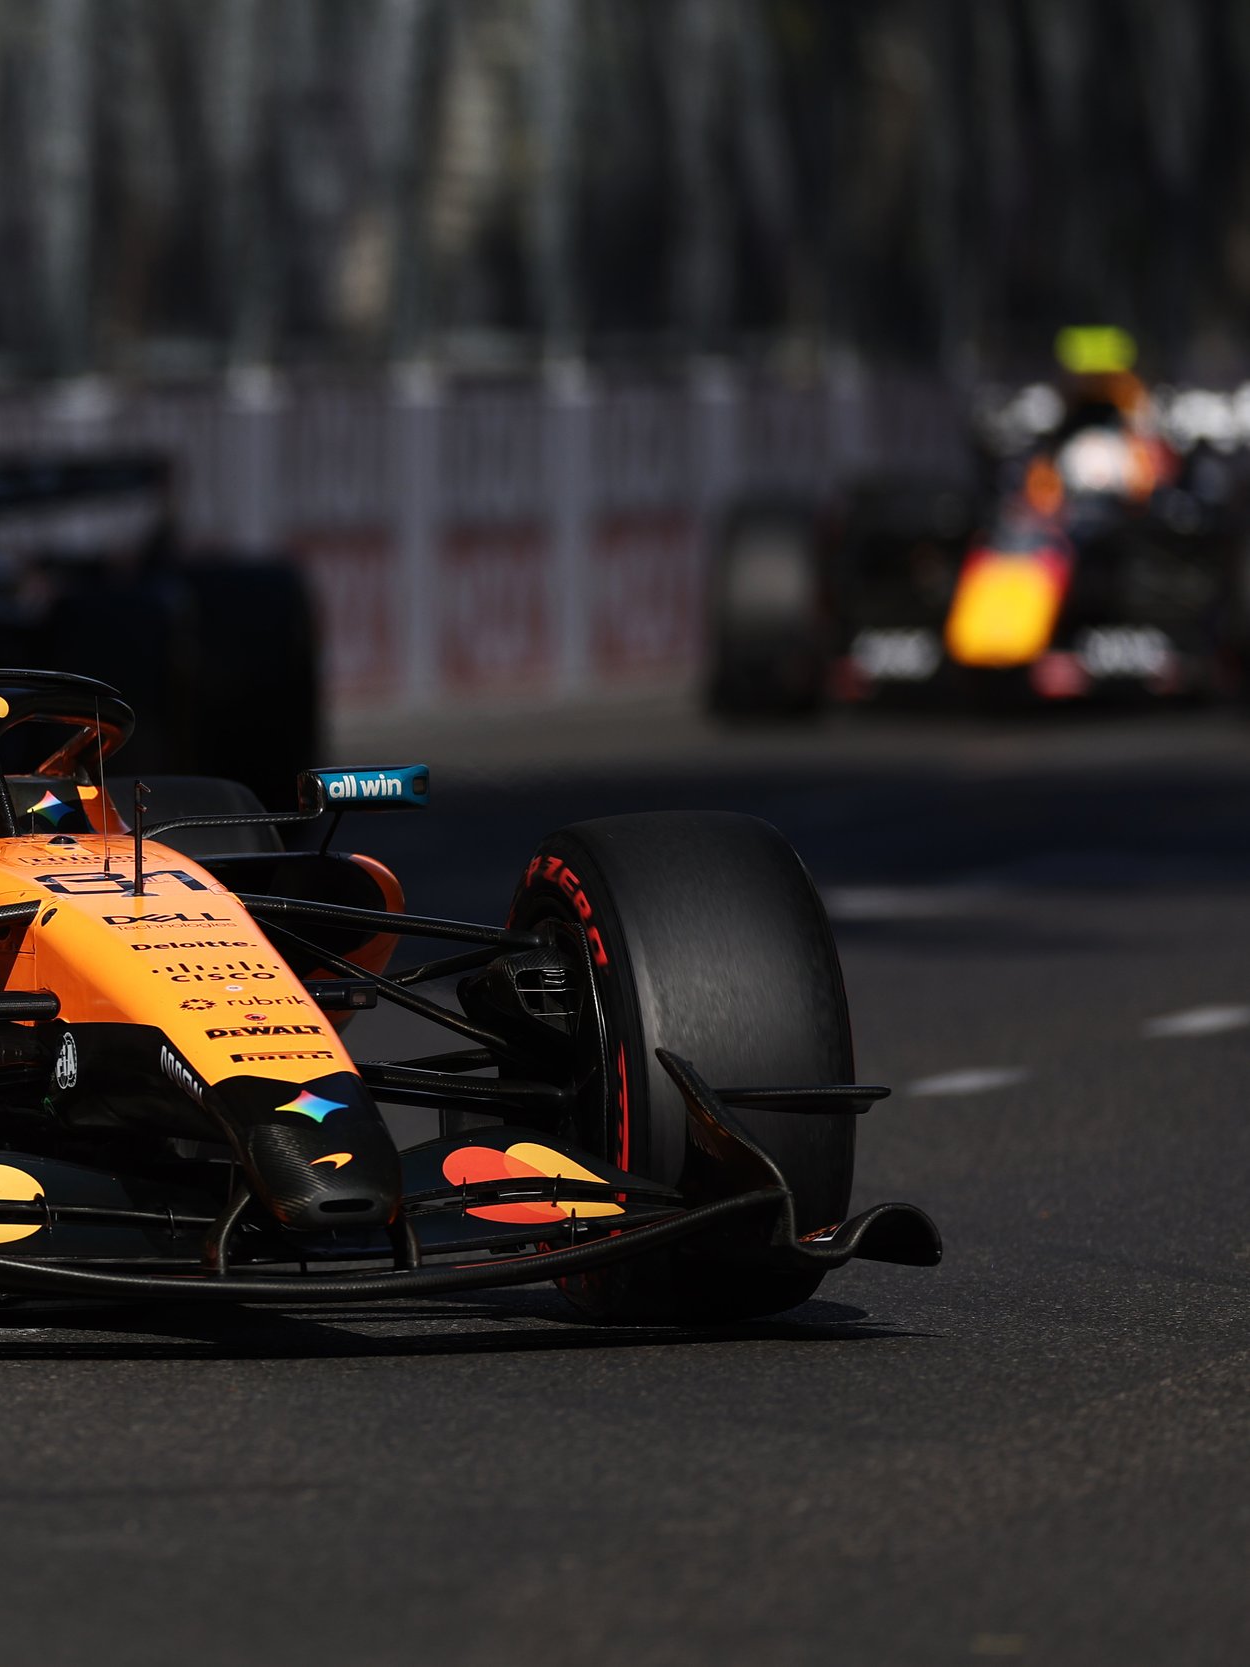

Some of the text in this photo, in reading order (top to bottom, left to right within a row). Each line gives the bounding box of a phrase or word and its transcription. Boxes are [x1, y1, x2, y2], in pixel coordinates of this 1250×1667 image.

[329, 773, 402, 798] all win
[102, 912, 231, 925] DELL
[117, 920, 238, 931] Technologies
[130, 940, 258, 951] Deloitte.
[171, 972, 276, 983] CISCO
[225, 995, 310, 1007] rubrik
[229, 1050, 335, 1064] PIRELLI
